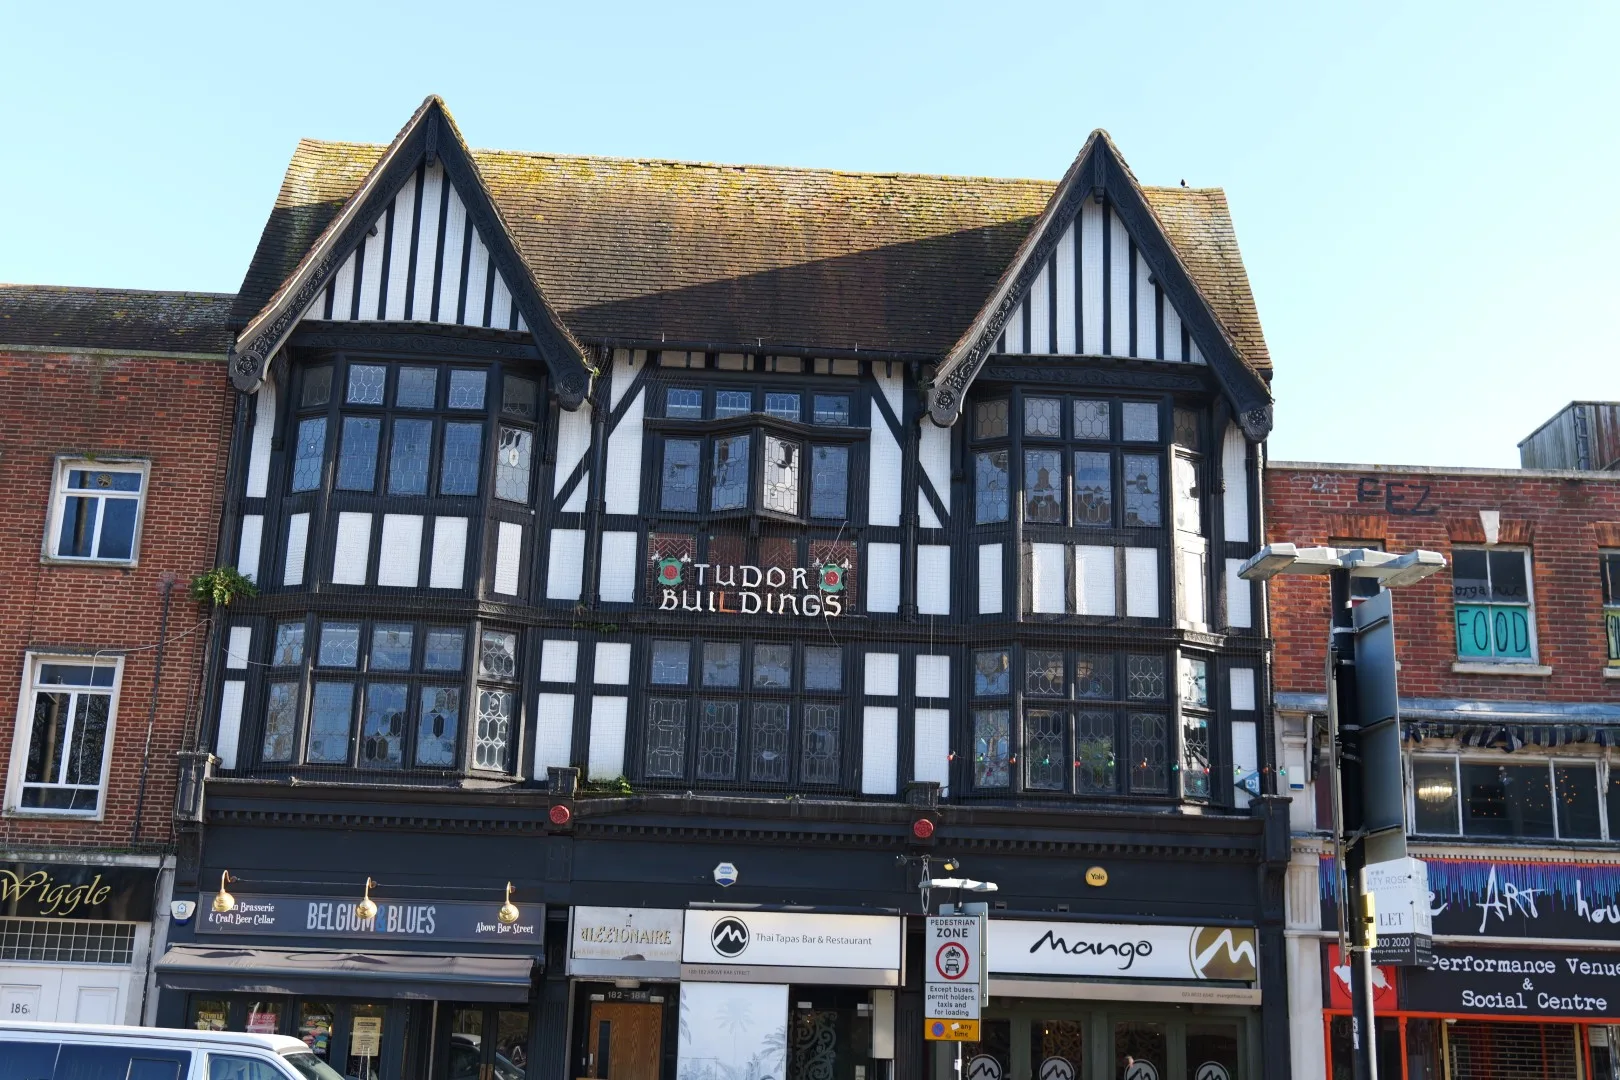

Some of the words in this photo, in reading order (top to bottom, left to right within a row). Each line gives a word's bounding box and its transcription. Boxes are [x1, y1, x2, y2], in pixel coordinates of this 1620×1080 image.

[694, 564, 808, 589] TUDOR
[658, 589, 842, 617] BUILDINGS
[1457, 610, 1528, 652] FOOD
[0, 869, 111, 916] Wiggle
[1476, 864, 1545, 933] ART
[240, 902, 275, 912] Brasserie
[208, 914, 214, 922] &
[215, 914, 234, 924] Craft
[235, 914, 252, 925] Beer
[253, 915, 275, 926] Cellar
[387, 905, 436, 934] BLUES
[1380, 912, 1405, 926] LET
[475, 922, 495, 933] Above
[497, 923, 511, 934] Bar
[513, 923, 534, 934] Street
[936, 928, 969, 938] ZONE
[756, 933, 774, 942] Thai
[775, 934, 800, 944] Tapas
[802, 935, 815, 944] Bar
[818, 935, 824, 944] &
[826, 936, 872, 945] Restaurant
[1392, 937, 1411, 947] 2020
[1030, 930, 1152, 970] Mango
[1523, 978, 1534, 990] &
[608, 991, 622, 999] 182
[1462, 990, 1527, 1008] Social
[1538, 993, 1607, 1010] Centre
